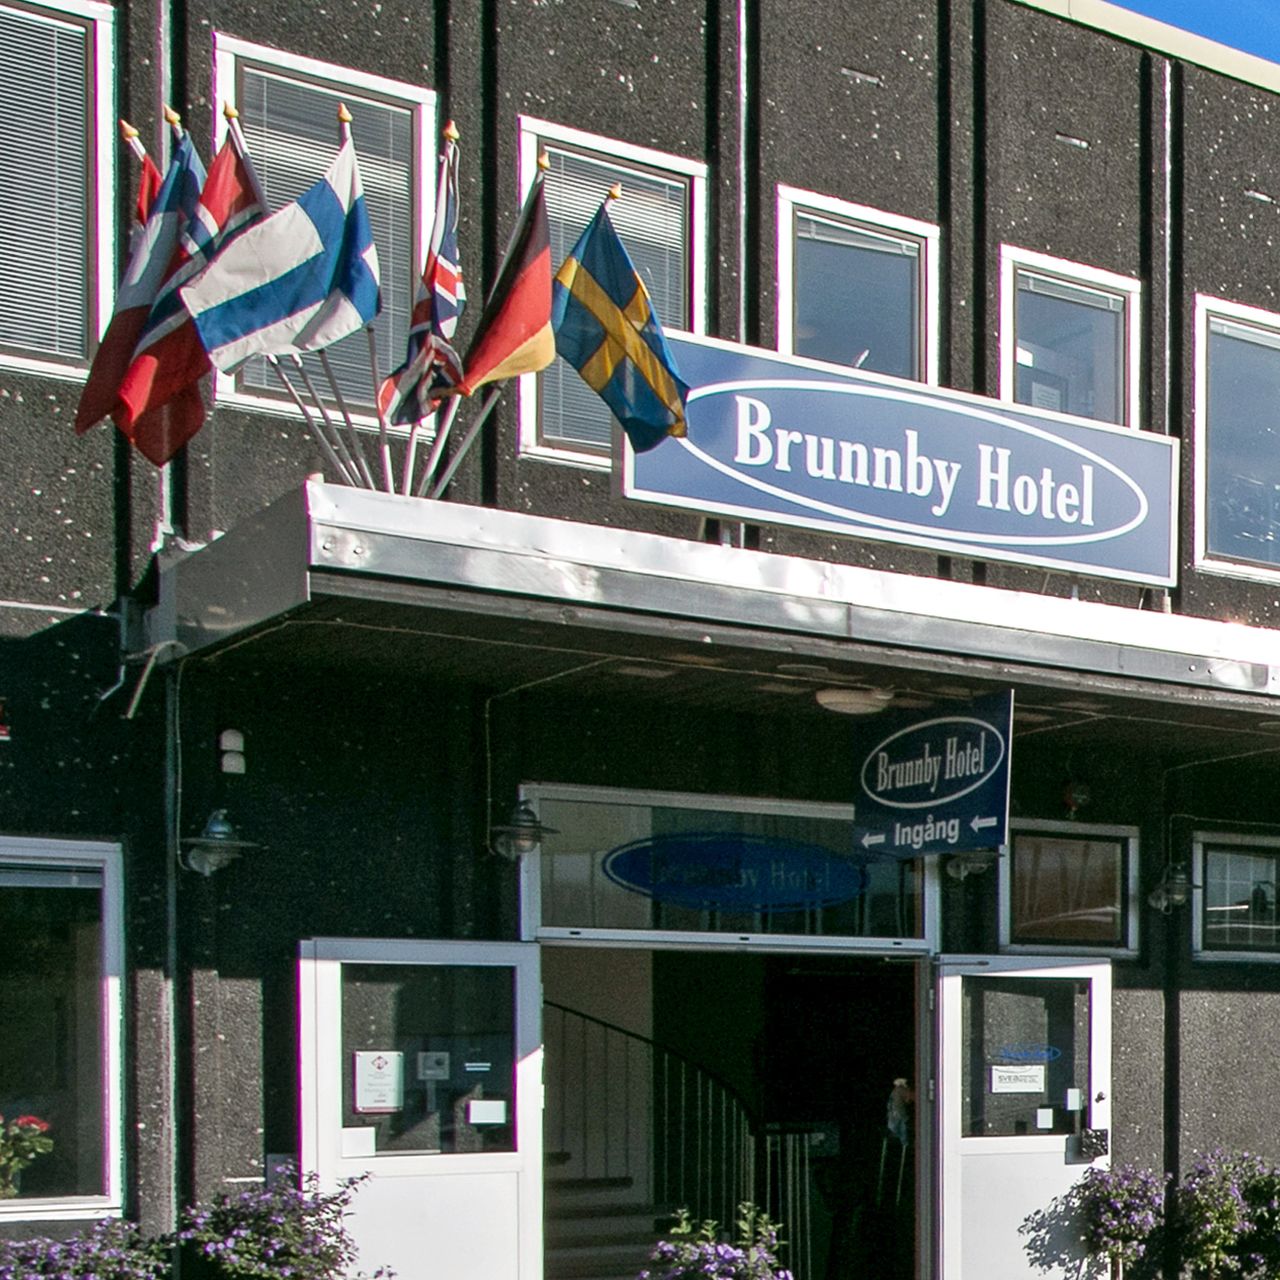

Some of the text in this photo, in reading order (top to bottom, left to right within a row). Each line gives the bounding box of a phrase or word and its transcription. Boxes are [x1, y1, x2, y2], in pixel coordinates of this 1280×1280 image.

[733, 394, 1096, 526] Brunnby Hotel
[876, 730, 986, 793] Brunnby Hotel
[894, 813, 960, 849] Ingång
